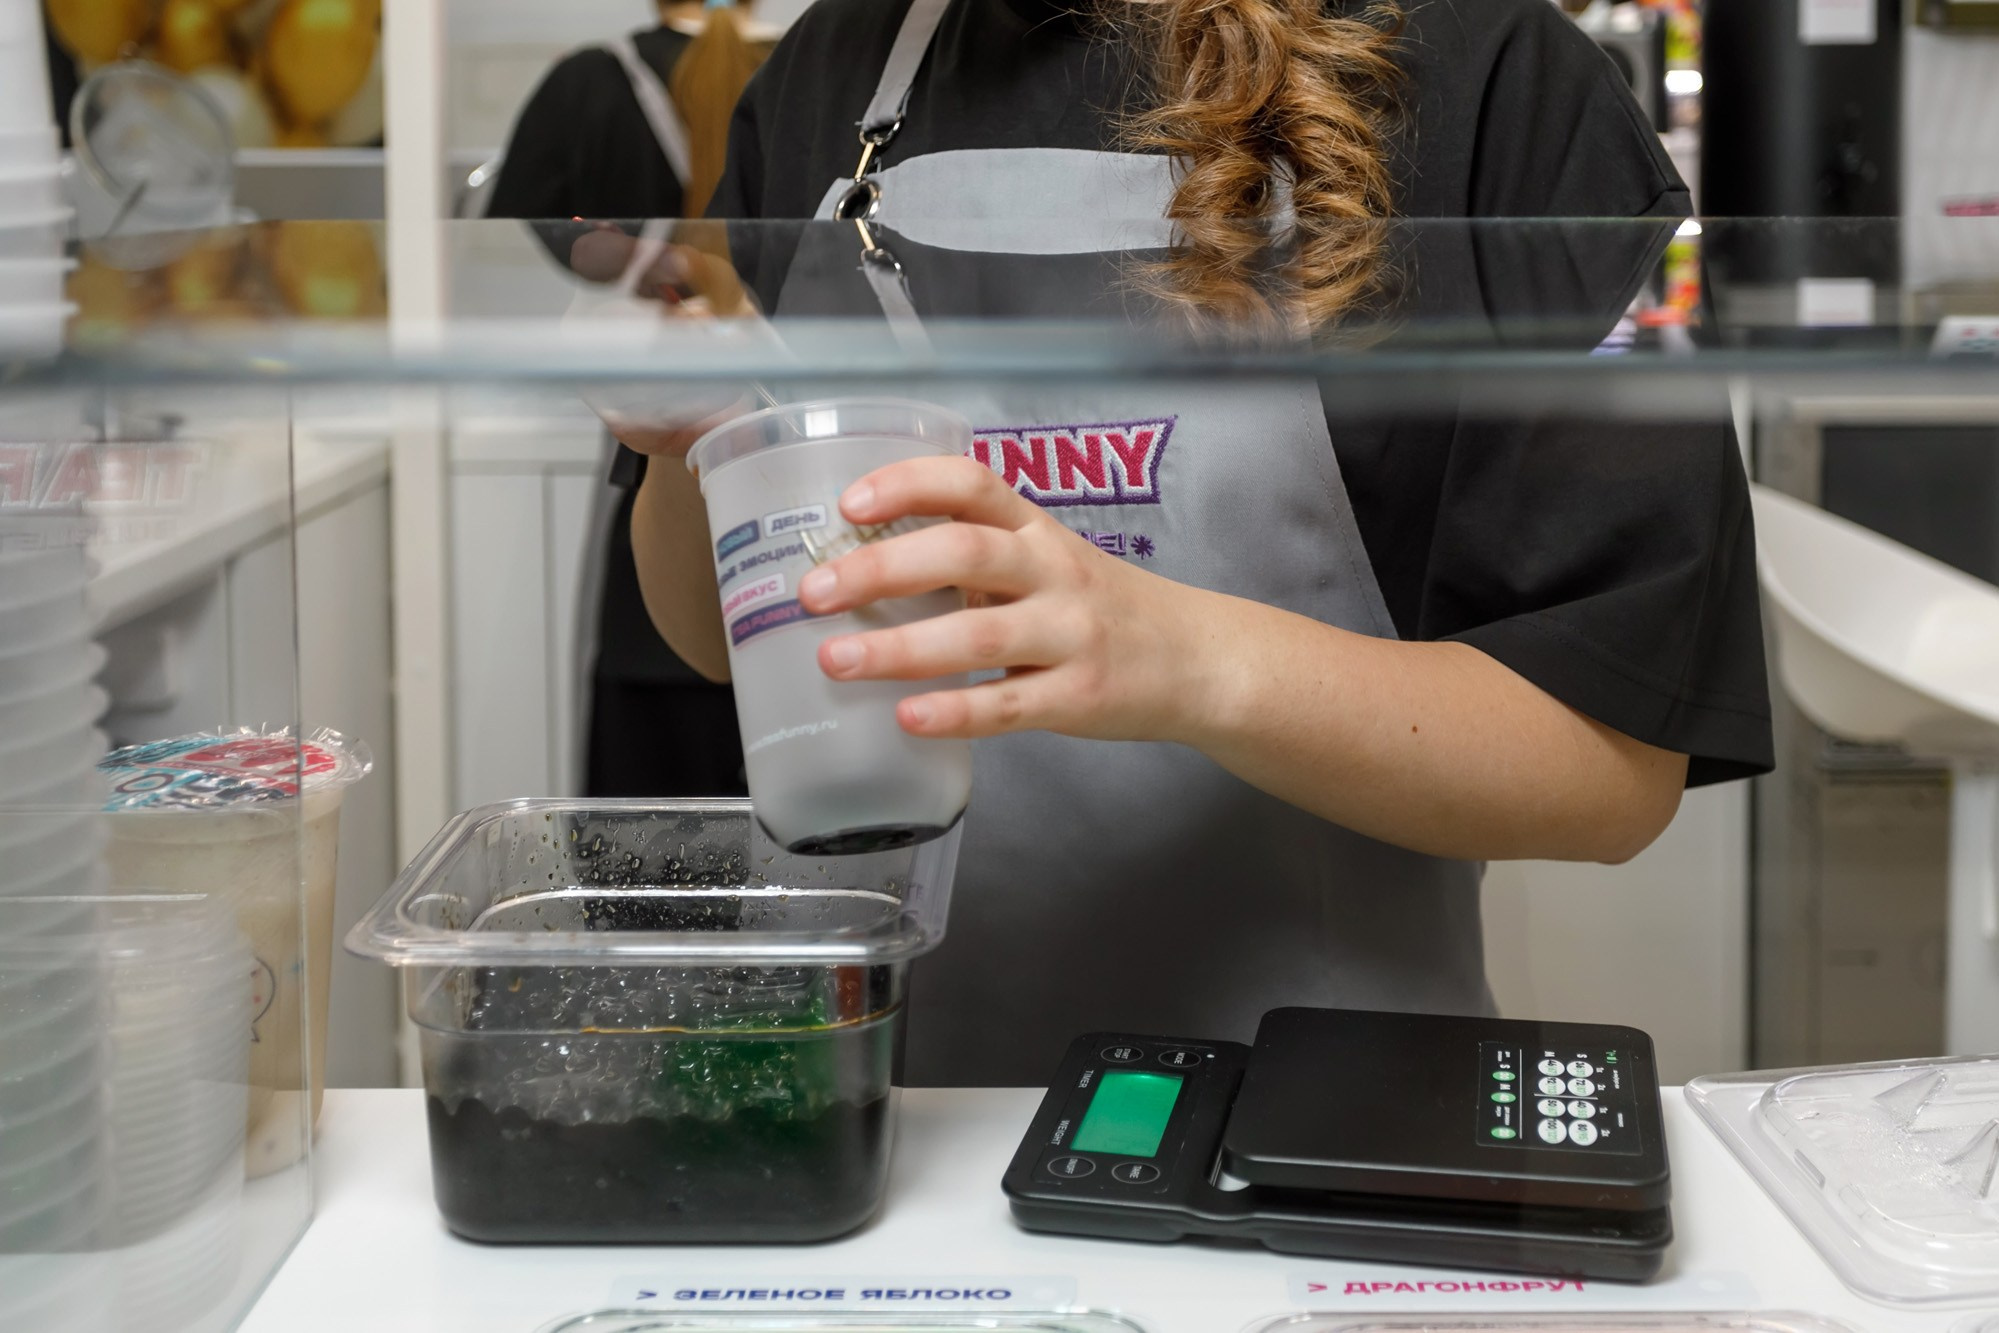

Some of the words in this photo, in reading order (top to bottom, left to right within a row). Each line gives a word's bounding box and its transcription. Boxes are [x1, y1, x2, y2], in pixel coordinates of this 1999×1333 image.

[771, 511, 821, 533] ДЕНЬ
[1173, 1052, 1186, 1064] MODE
[1078, 1069, 1094, 1089] TIMER
[1051, 1119, 1071, 1146] WEIGHT
[1129, 1165, 1142, 1179] TARE
[673, 1288, 846, 1301] ЗЕЛЕНОЕ
[859, 1288, 1013, 1301] ЯБЛОКО
[1343, 1280, 1587, 1295] ДРАГОНФРУТ
